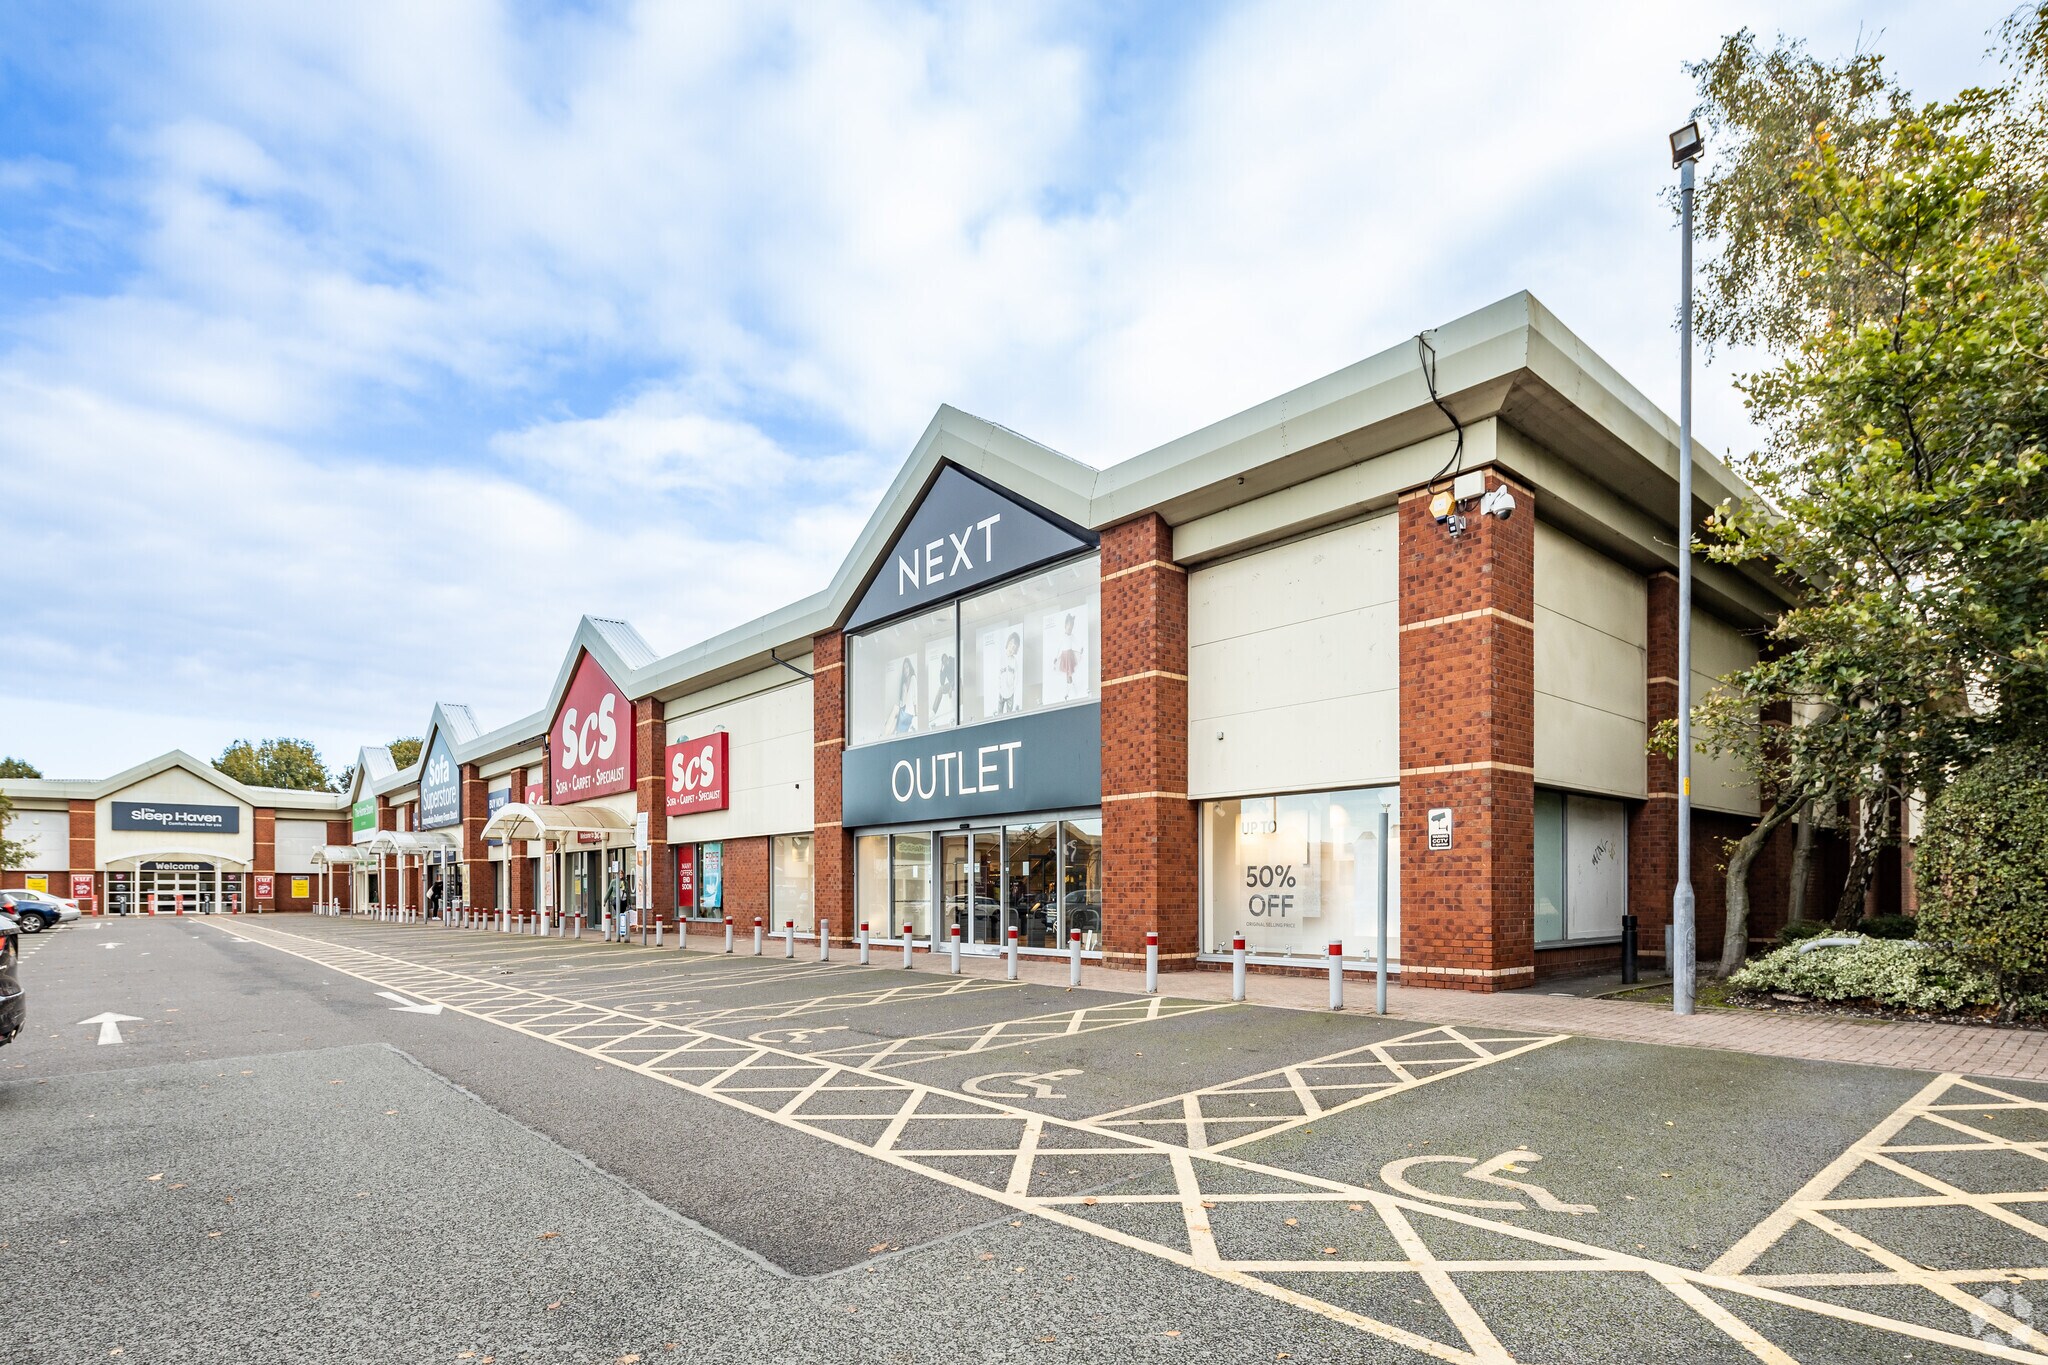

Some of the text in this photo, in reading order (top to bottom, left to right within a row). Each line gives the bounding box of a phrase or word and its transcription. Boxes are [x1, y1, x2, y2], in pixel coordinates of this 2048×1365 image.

[898, 513, 1001, 596] NEXT
[562, 692, 617, 770] ScS
[429, 753, 450, 787] Sofa
[572, 774, 591, 791] CARPET
[596, 766, 625, 786] SPECIALIST
[671, 745, 714, 793] ScS
[891, 741, 1023, 803] OUTLET
[423, 785, 457, 815] Superstore
[680, 793, 695, 805] CARPET
[698, 789, 720, 801] SPECIALIST
[131, 808, 222, 825] Sleep Haven
[1241, 820, 1277, 835] UP TO
[155, 862, 200, 871] Welcome
[1246, 865, 1296, 888] 50%
[1248, 894, 1294, 917] OFF
